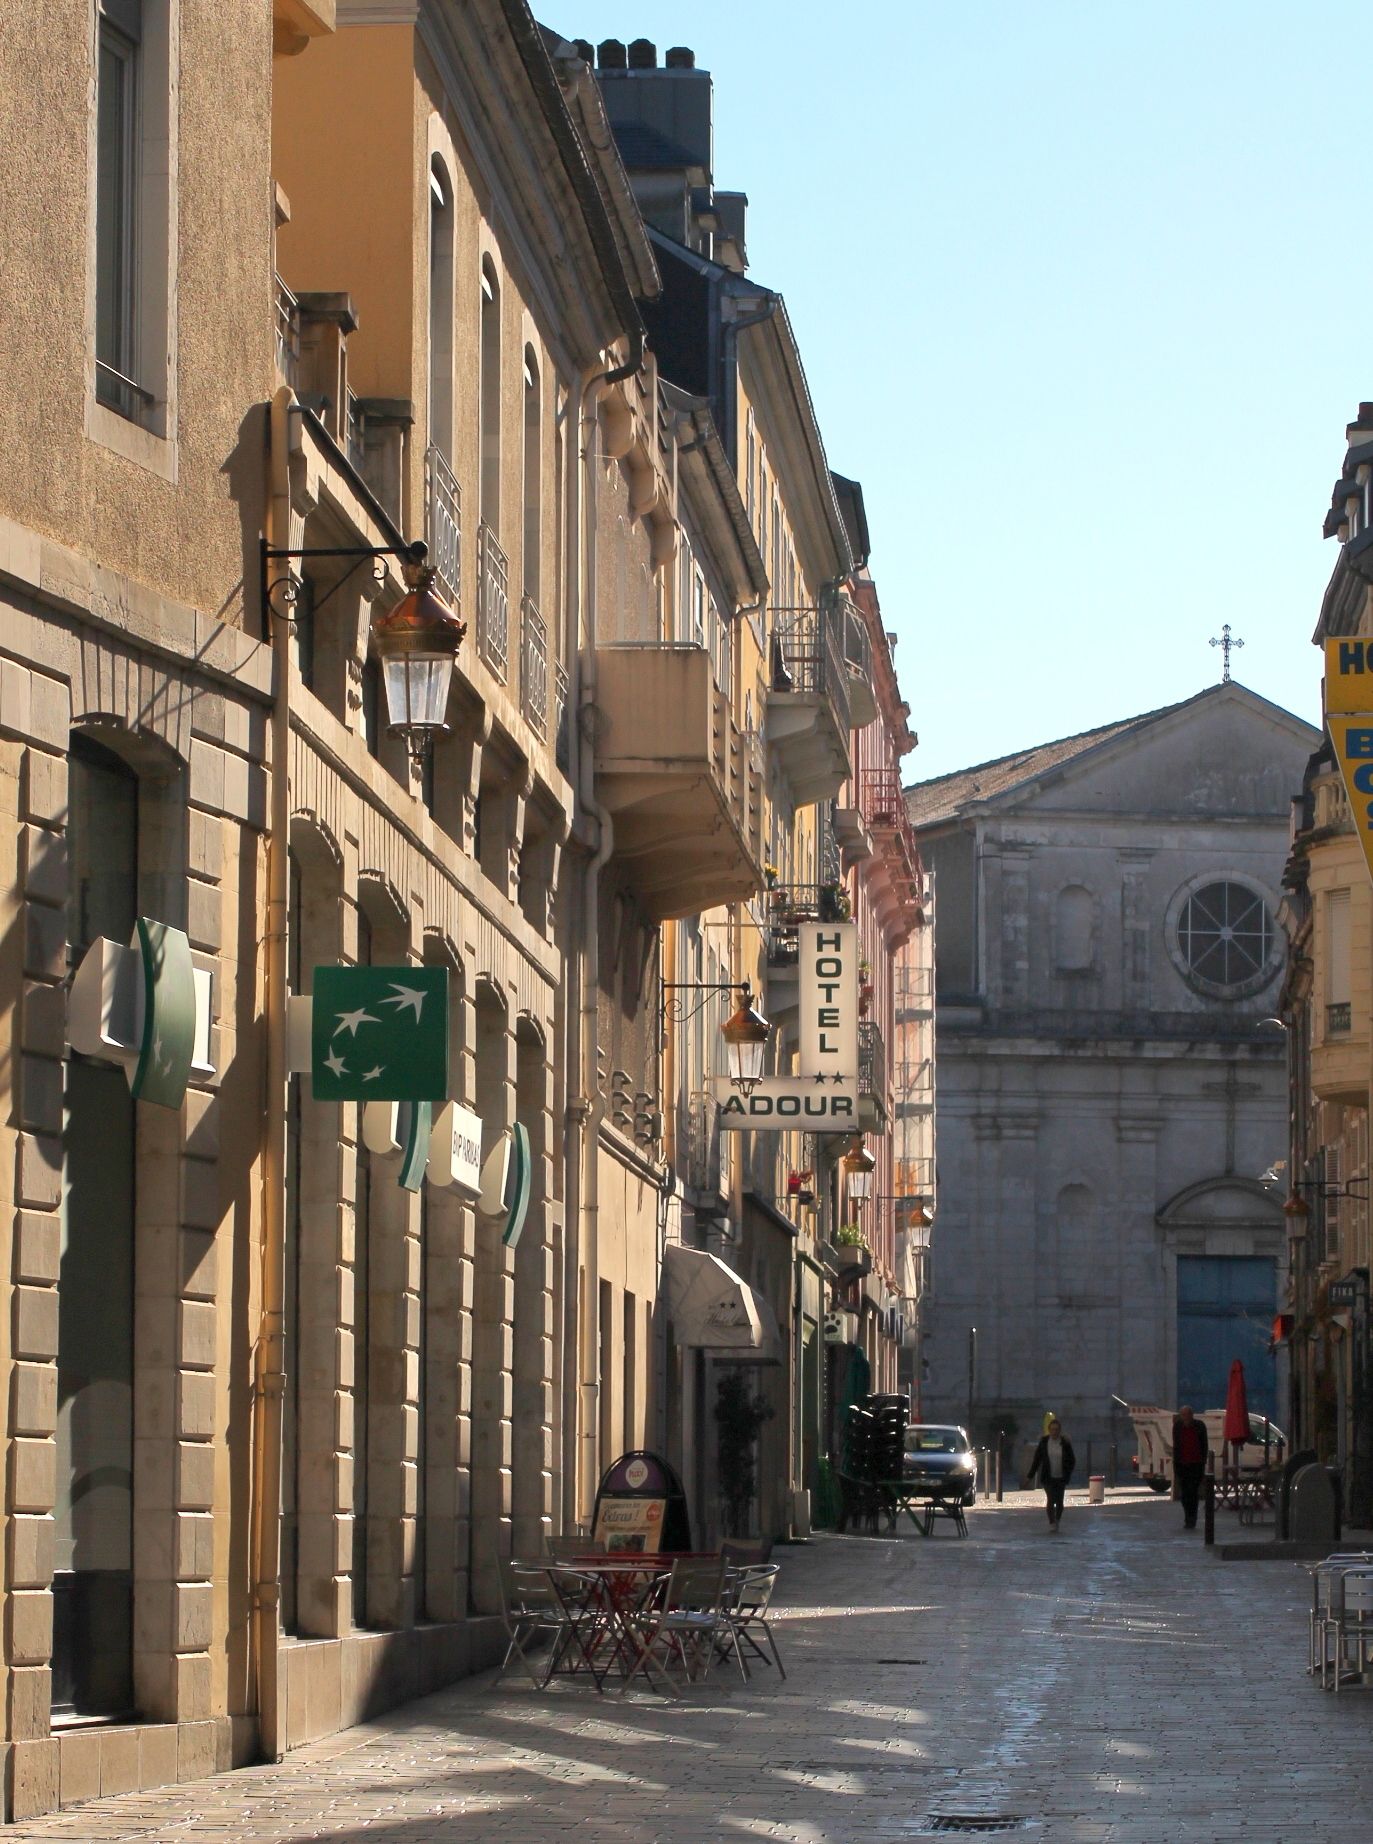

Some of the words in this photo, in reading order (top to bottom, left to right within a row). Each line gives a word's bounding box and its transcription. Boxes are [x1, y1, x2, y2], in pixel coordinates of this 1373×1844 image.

[816, 932, 842, 1053] HOTEL
[721, 1095, 853, 1116] ADOUR
[1332, 1286, 1354, 1297] FIKA
